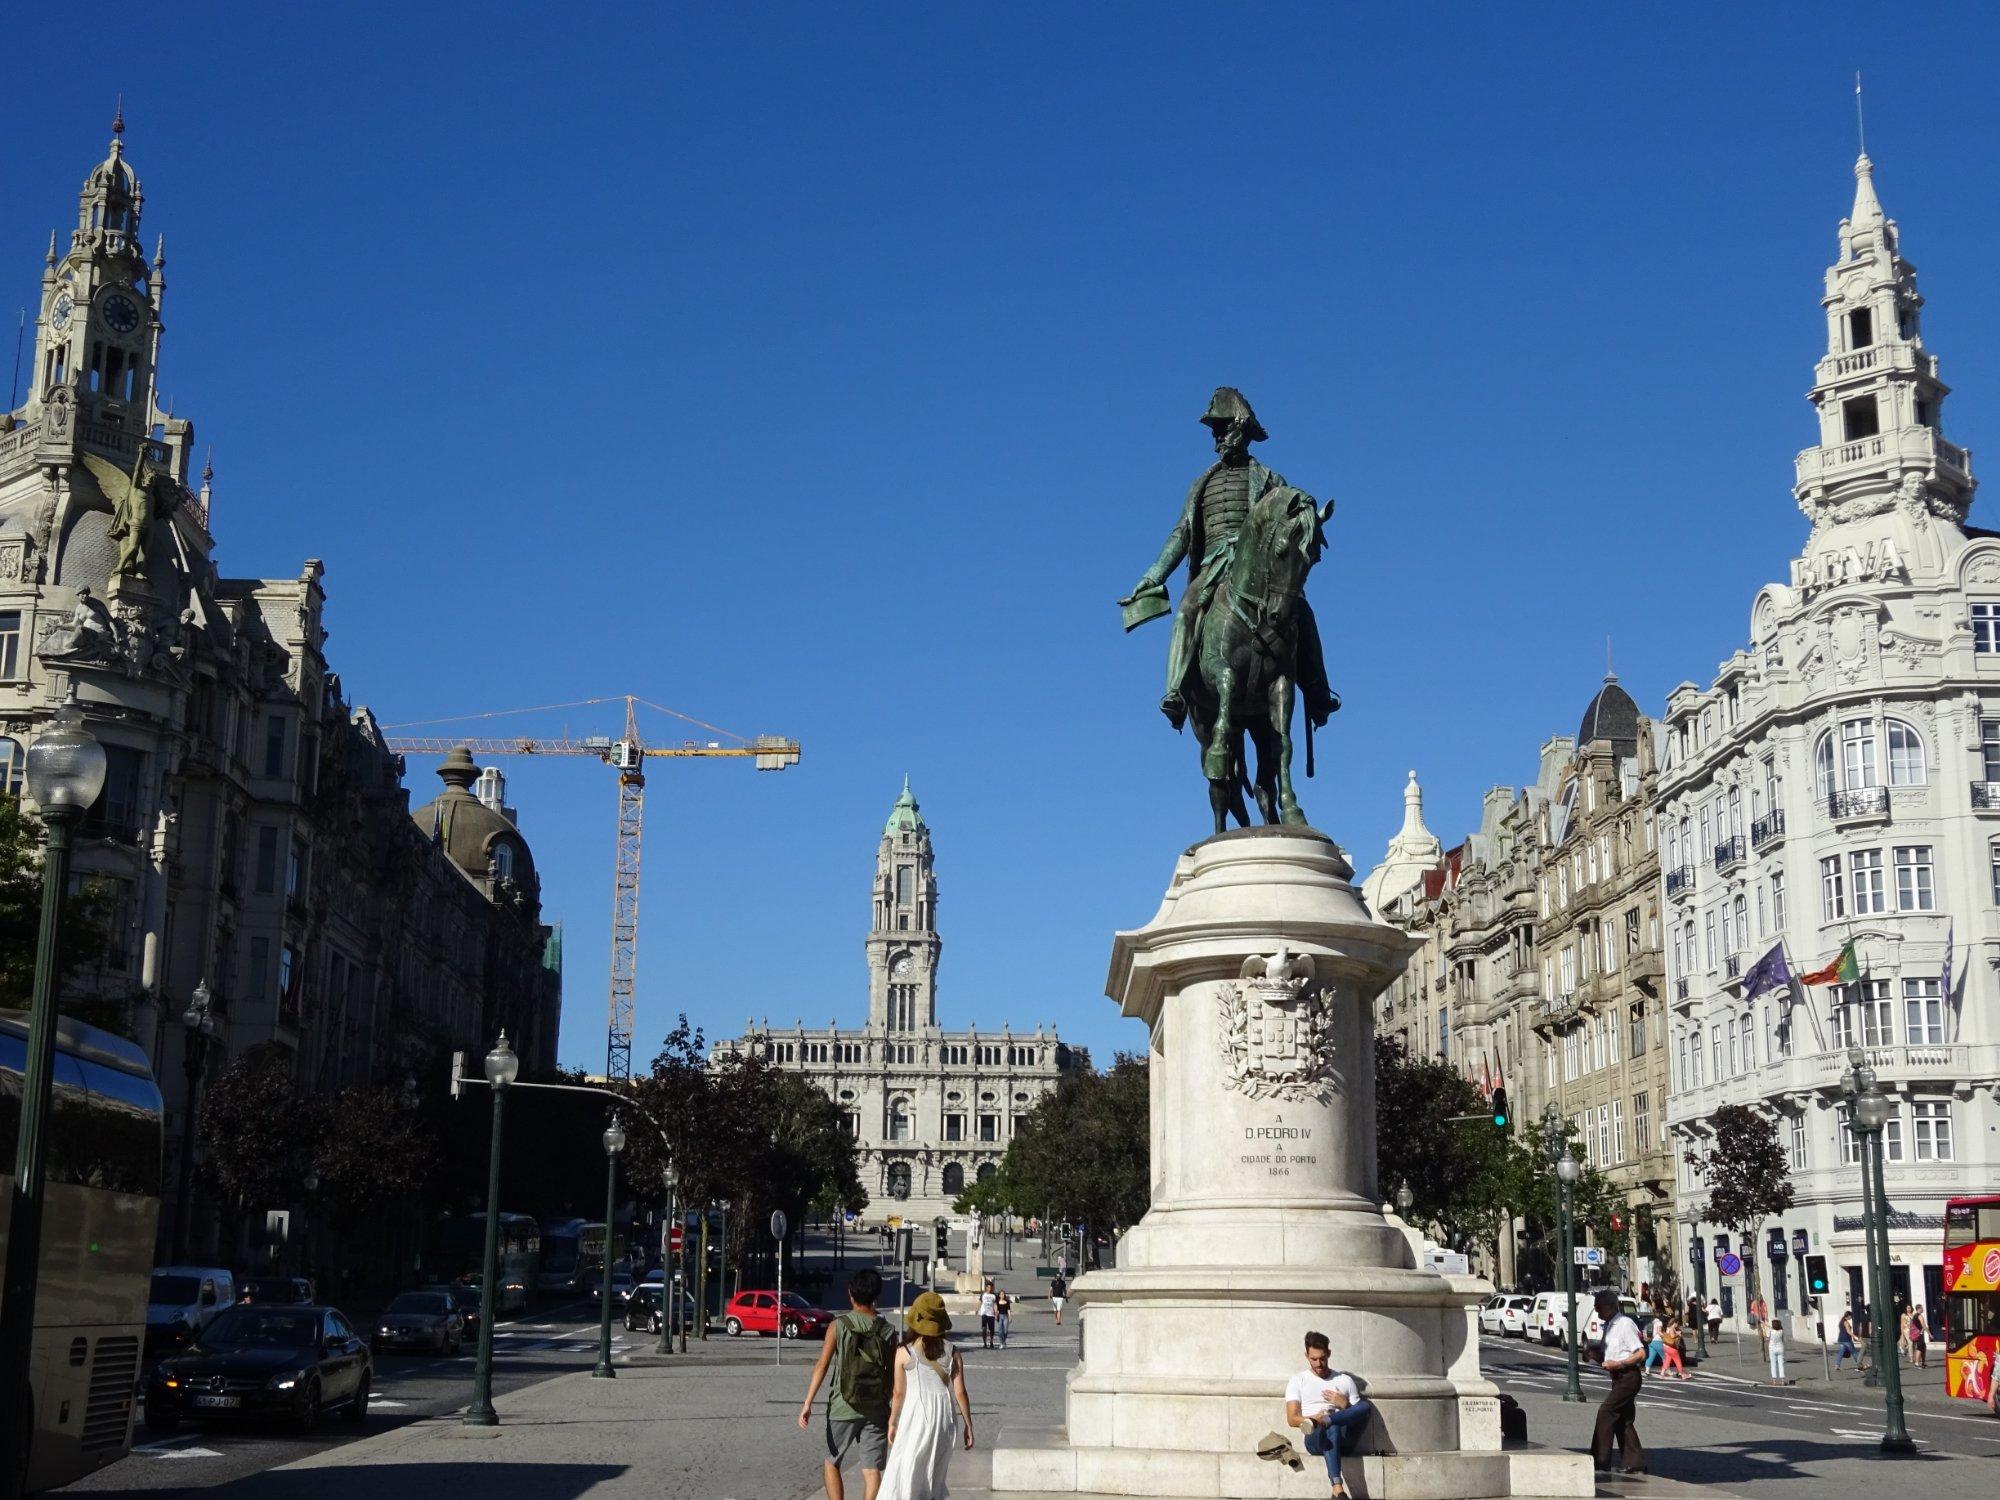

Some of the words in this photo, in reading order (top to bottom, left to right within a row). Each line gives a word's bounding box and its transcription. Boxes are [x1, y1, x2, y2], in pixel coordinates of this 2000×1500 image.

[1790, 537, 1904, 590] BBVA
[1275, 1114, 1283, 1124] A
[1301, 1128, 1312, 1139] IV
[1276, 1143, 1283, 1151] A
[1241, 1155, 1271, 1164] CIDADE
[1275, 1155, 1287, 1164] DO
[1290, 1155, 1317, 1164] PORTO
[1268, 1167, 1290, 1176] 1866
